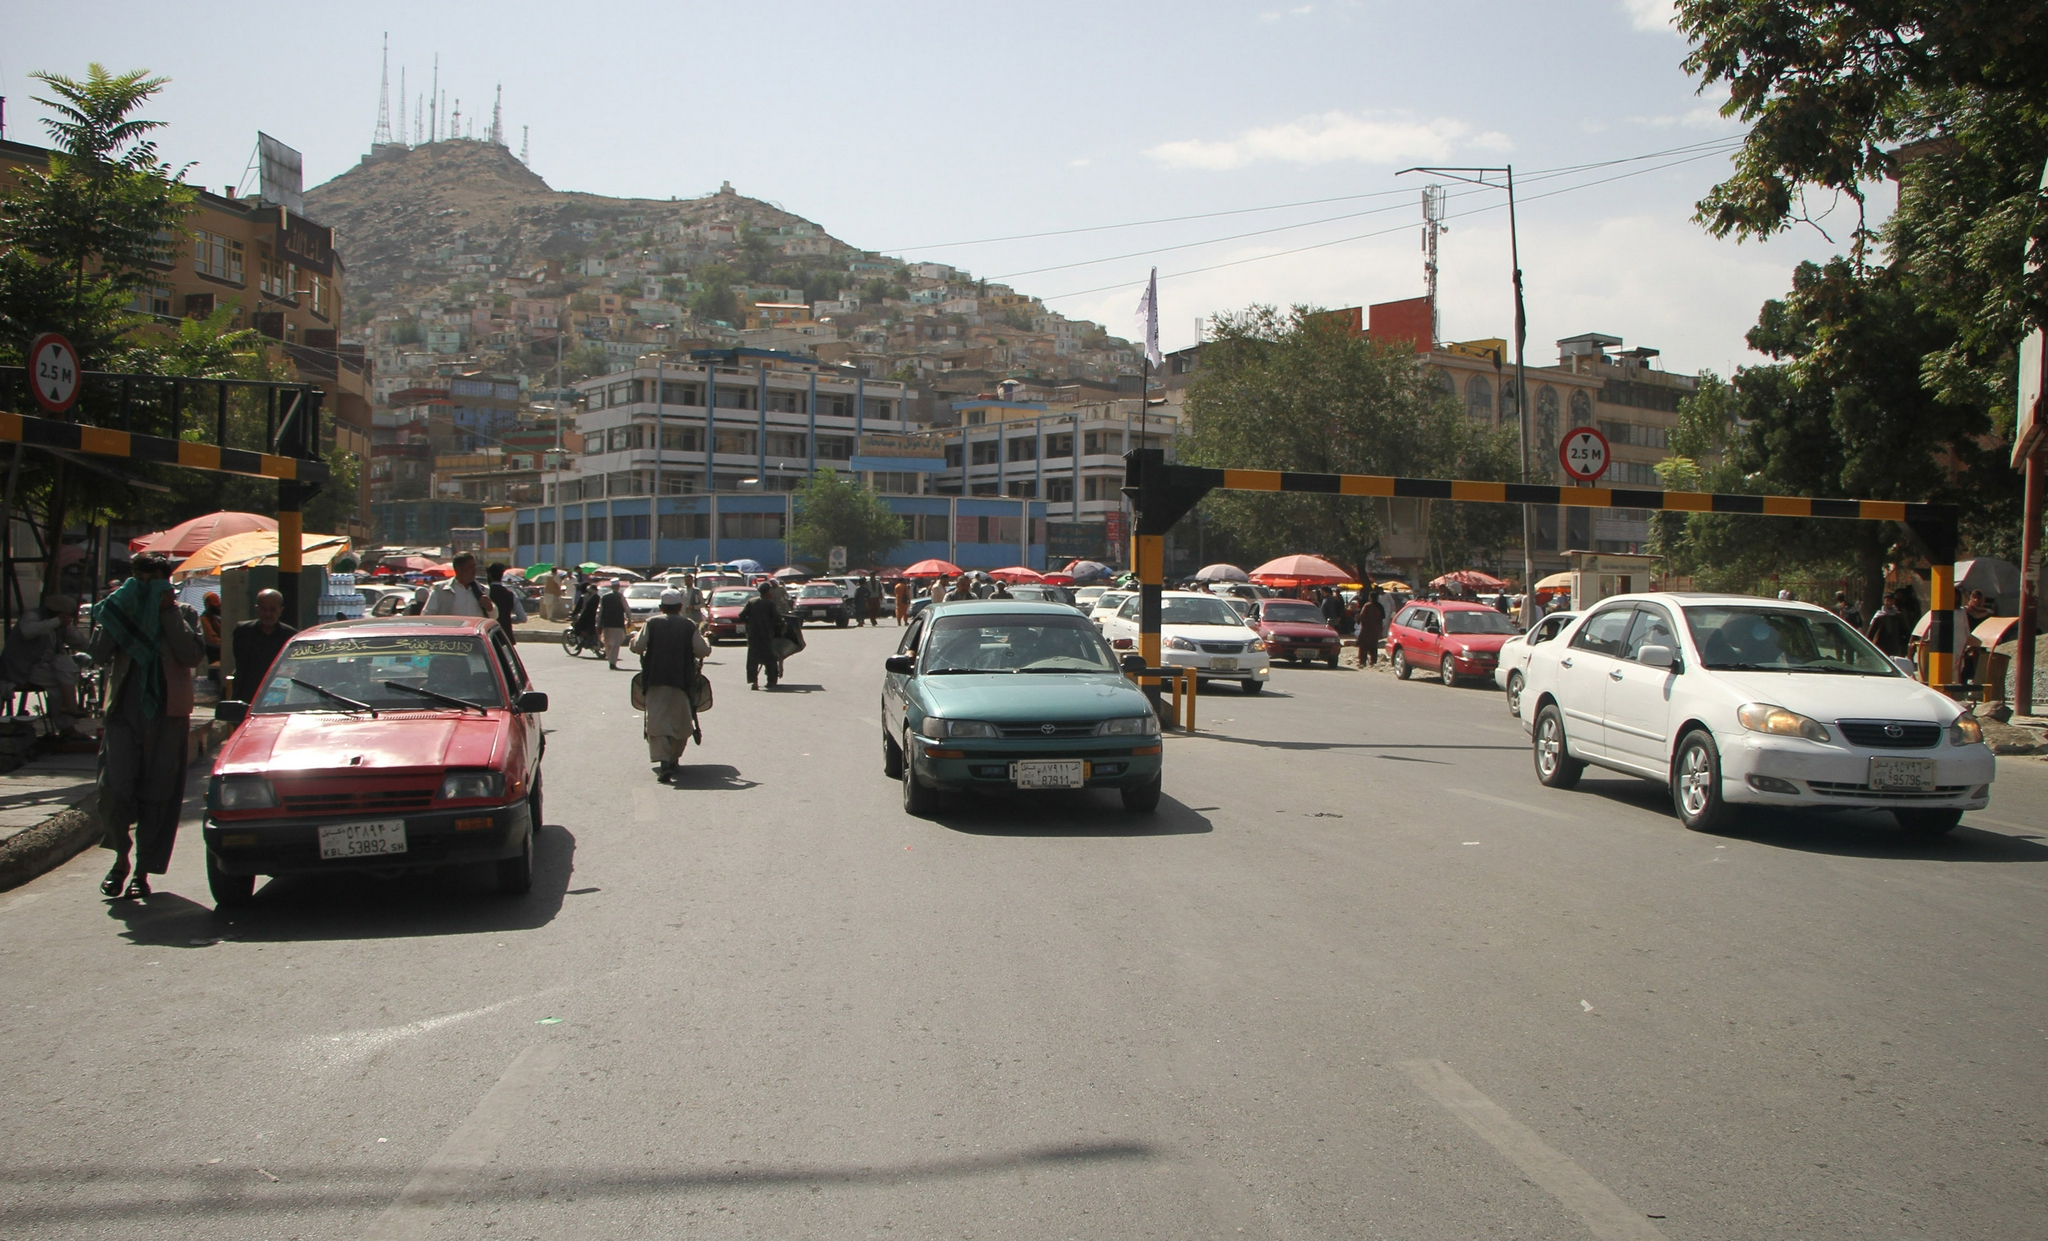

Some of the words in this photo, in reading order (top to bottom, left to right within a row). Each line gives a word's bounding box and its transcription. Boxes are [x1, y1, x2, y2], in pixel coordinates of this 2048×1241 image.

[40, 362, 59, 381] 2.5
[61, 367, 72, 384] M
[1571, 448, 1588, 460] 2.5
[1591, 449, 1602, 460] M
[1042, 775, 1069, 786] 87911
[1893, 774, 1921, 786] 95796
[348, 838, 387, 855] 53892
[391, 843, 404, 852] SH
